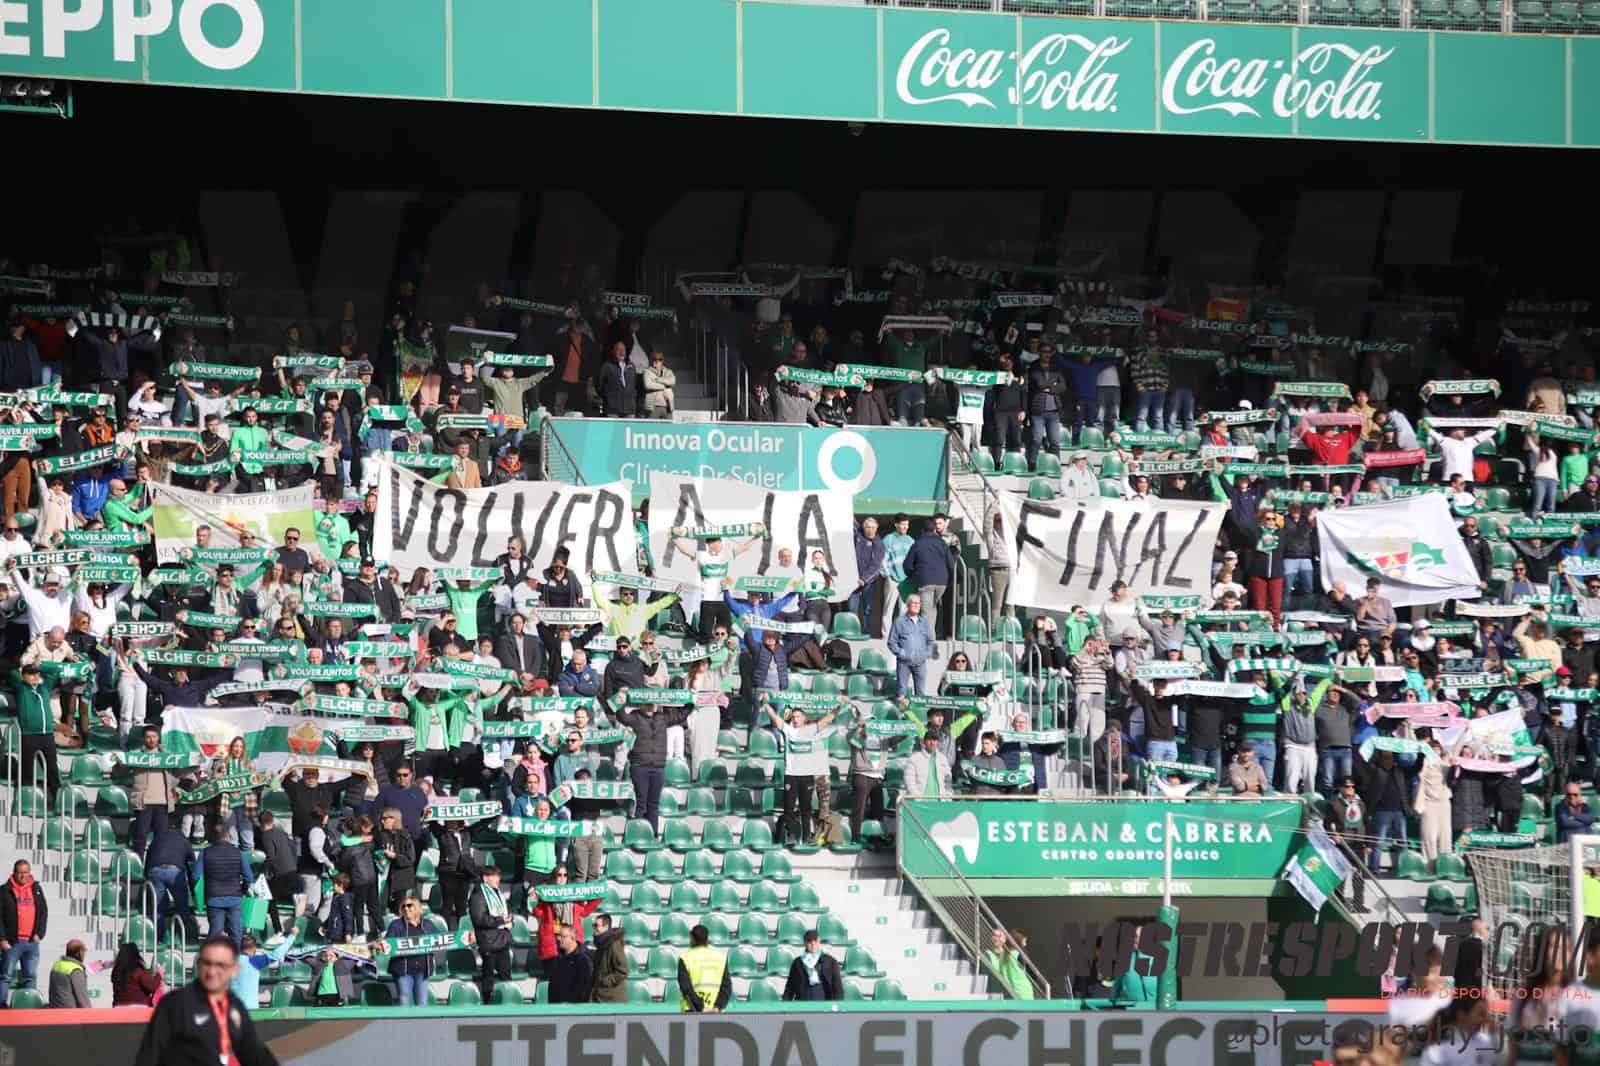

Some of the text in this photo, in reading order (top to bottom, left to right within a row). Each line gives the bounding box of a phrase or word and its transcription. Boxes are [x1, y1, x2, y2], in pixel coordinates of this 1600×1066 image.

[192, 365, 254, 376] VOLVER JUNTOS
[625, 427, 784, 454] Innova Ocular
[59, 446, 114, 467] ELCHE
[244, 451, 306, 460] VOLVER JUNTOS
[1144, 461, 1198, 472] ELCHE CF
[391, 470, 625, 575] VOLVER
[69, 533, 131, 542] VOLVER JUNTOS
[1015, 501, 1210, 590] FINAL
[21, 551, 86, 565] ELCHE CF
[197, 551, 261, 560] VOLVER JUNTOS
[307, 603, 371, 613] VOLVER JUNTOS
[193, 615, 221, 623] VOLVER
[147, 651, 214, 665] ELCHE CF
[290, 668, 353, 677] VOLVER JUNTOS
[446, 659, 507, 677] VOLVER JUNTOS
[379, 674, 408, 685] ELCH
[321, 699, 365, 713] ELCHE
[367, 701, 385, 713] CF
[437, 805, 481, 817] ELCHE
[987, 821, 1274, 844] ESTEBAN & CABRERA
[1041, 847, 1221, 862] CENTRO ODONTOÓGICO
[541, 886, 607, 897] VOLVER JUNTOS
[397, 933, 456, 949] ELCHE
[457, 1024, 803, 1066] TIENDA
